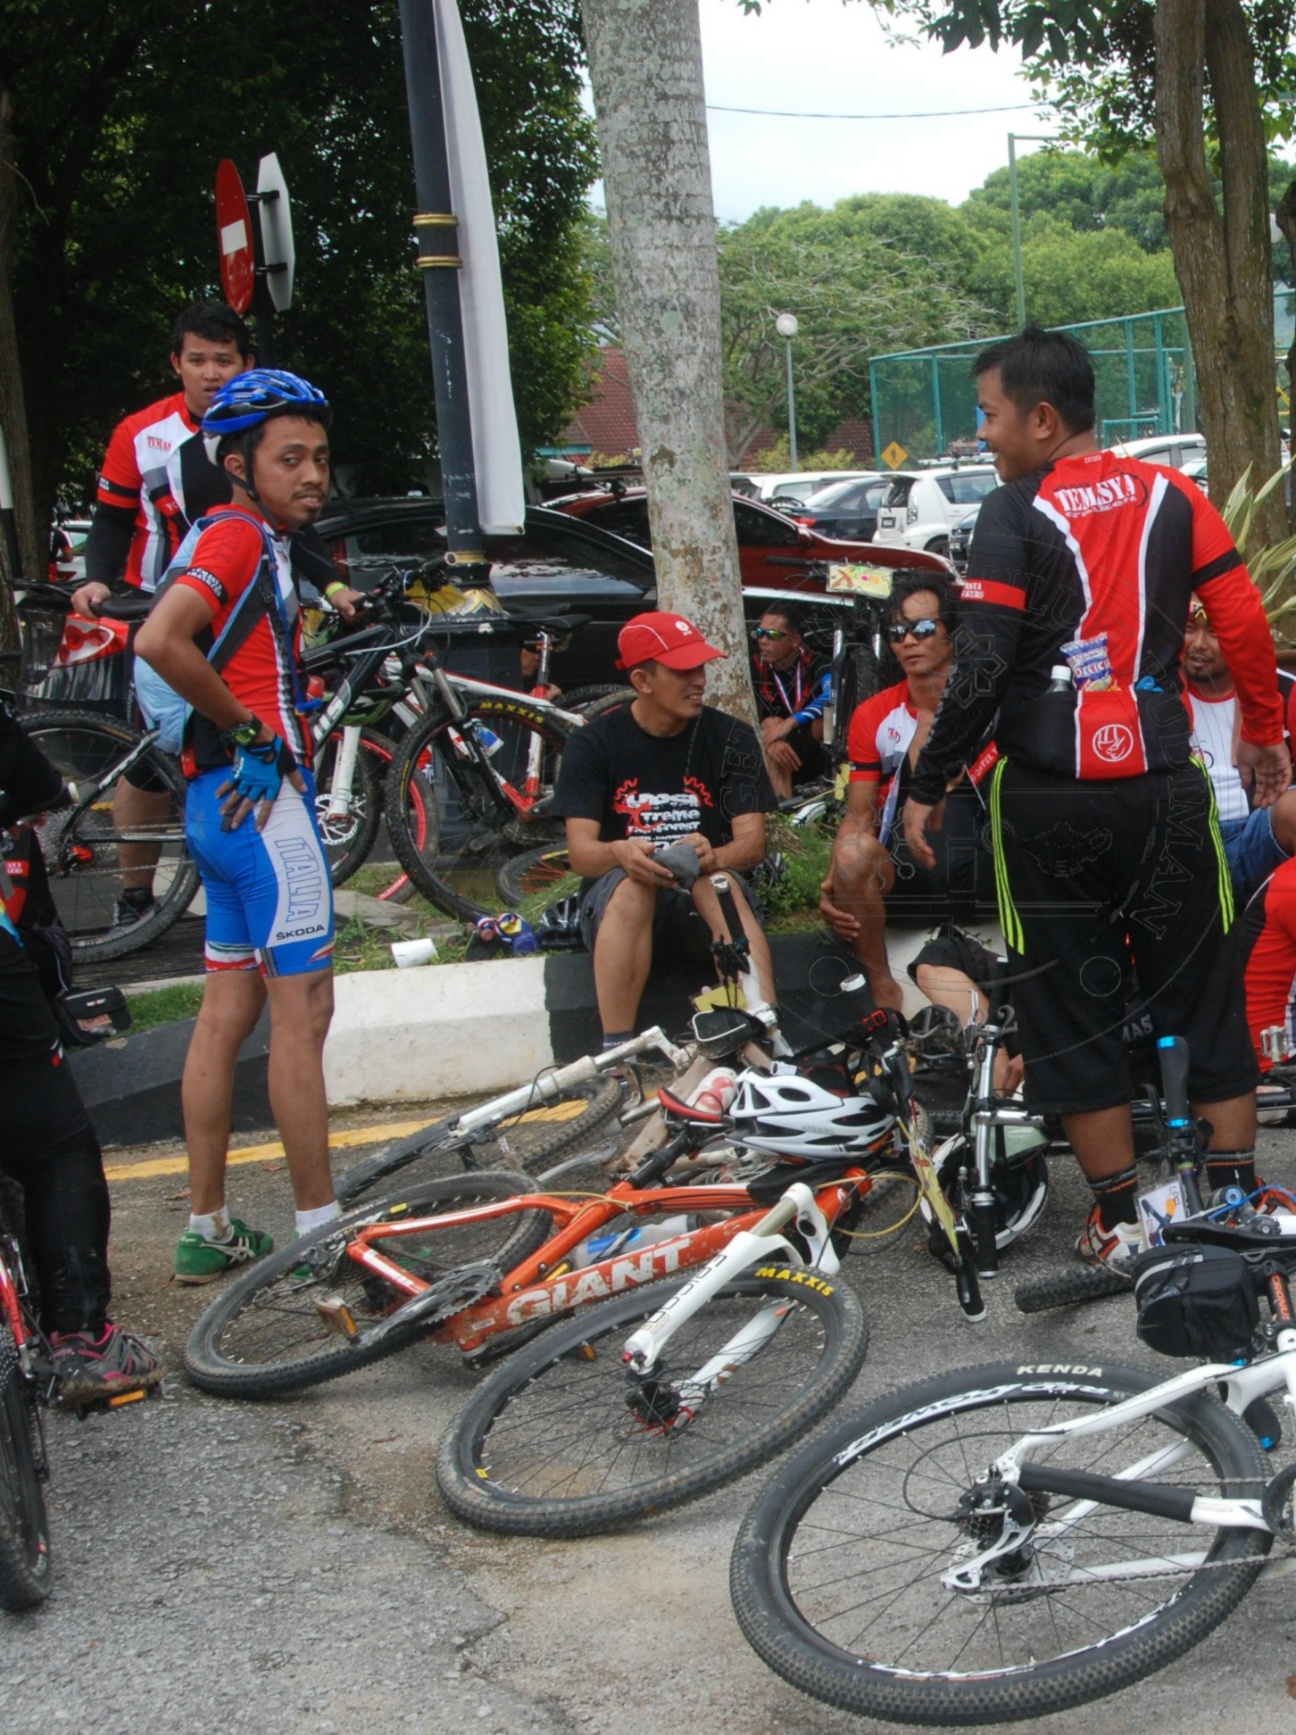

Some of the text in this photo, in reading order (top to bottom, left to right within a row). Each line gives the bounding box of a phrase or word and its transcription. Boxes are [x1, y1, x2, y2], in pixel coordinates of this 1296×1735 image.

[480, 701, 545, 725] MAXXIS
[274, 837, 322, 923] ITALIA
[506, 1237, 692, 1326] GIANT
[755, 1266, 835, 1298] MAXXIS
[1017, 1364, 1103, 1378] KENDA
